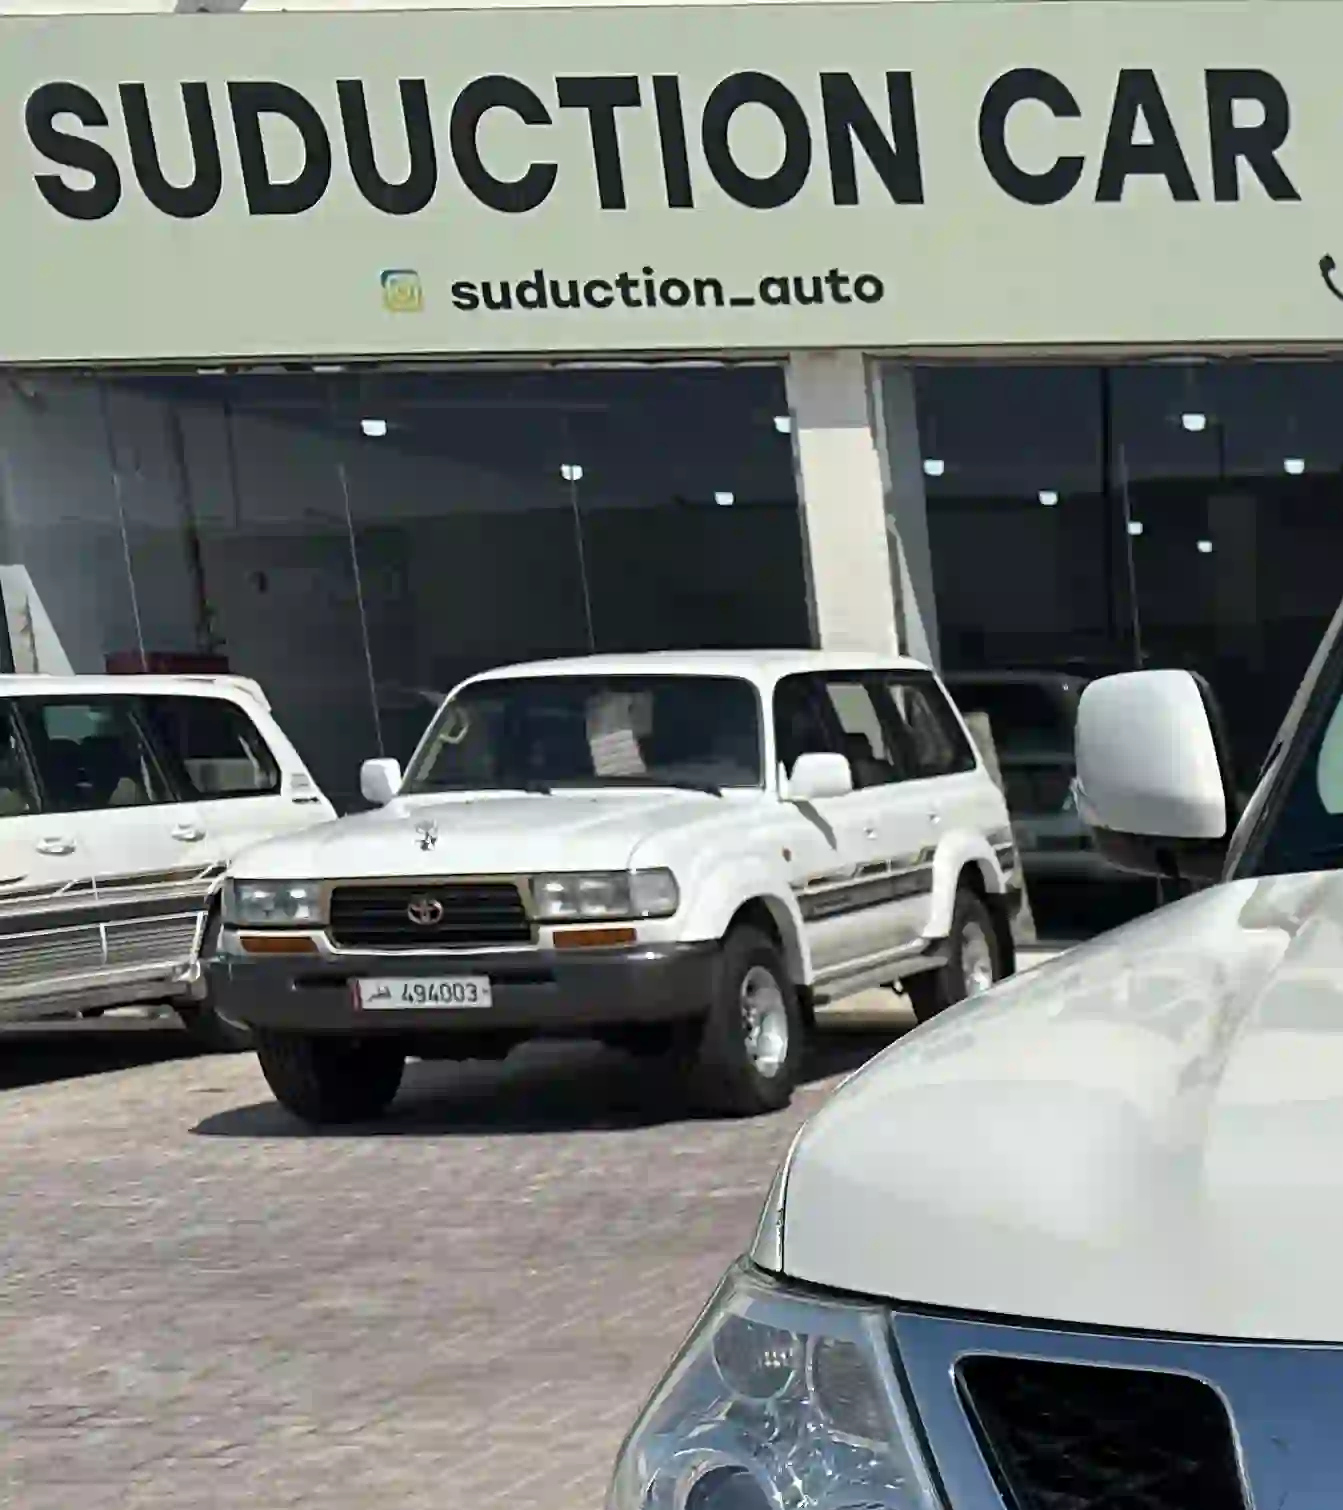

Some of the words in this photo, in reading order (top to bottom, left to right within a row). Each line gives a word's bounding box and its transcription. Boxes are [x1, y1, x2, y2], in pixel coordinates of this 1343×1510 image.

[25, 72, 925, 220] SUDUCTION
[978, 68, 1302, 205] CAR
[451, 265, 884, 311] suduction_auto
[402, 982, 478, 1004] 494003
